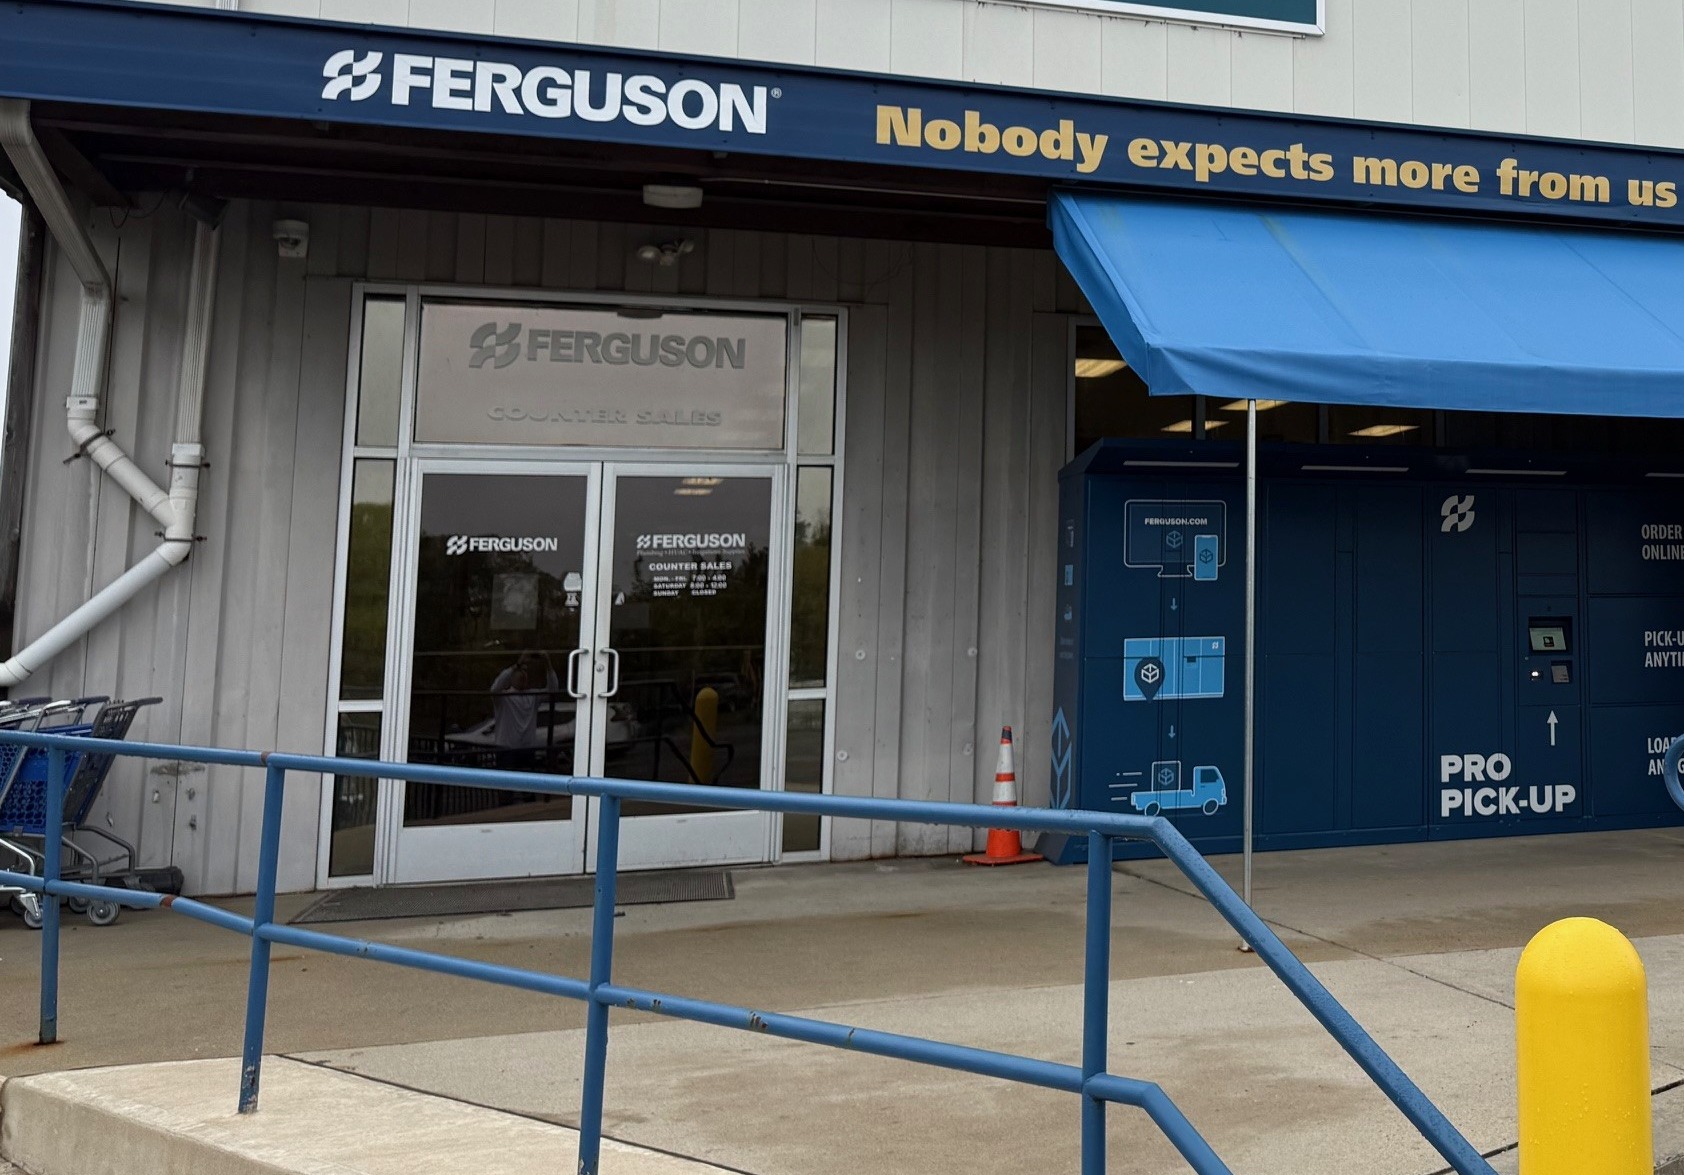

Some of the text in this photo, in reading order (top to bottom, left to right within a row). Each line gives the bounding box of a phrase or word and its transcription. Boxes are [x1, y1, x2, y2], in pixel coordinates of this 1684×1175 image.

[391, 53, 767, 134] FERGUSON
[876, 104, 1677, 208] Nobody expects more from us
[527, 328, 746, 369] FERGUSON
[487, 406, 722, 427] COUNTER SALES
[1144, 517, 1208, 526] FERGUSON.COM
[653, 533, 746, 549] FERGUSON
[1641, 524, 1683, 540] ORDER
[469, 537, 558, 552] FERGUSON
[649, 561, 732, 571] COUNTER SALES
[653, 582, 687, 590] SATURDAY
[1440, 753, 1512, 783] PRO
[1441, 784, 1576, 817] PICK-UP
